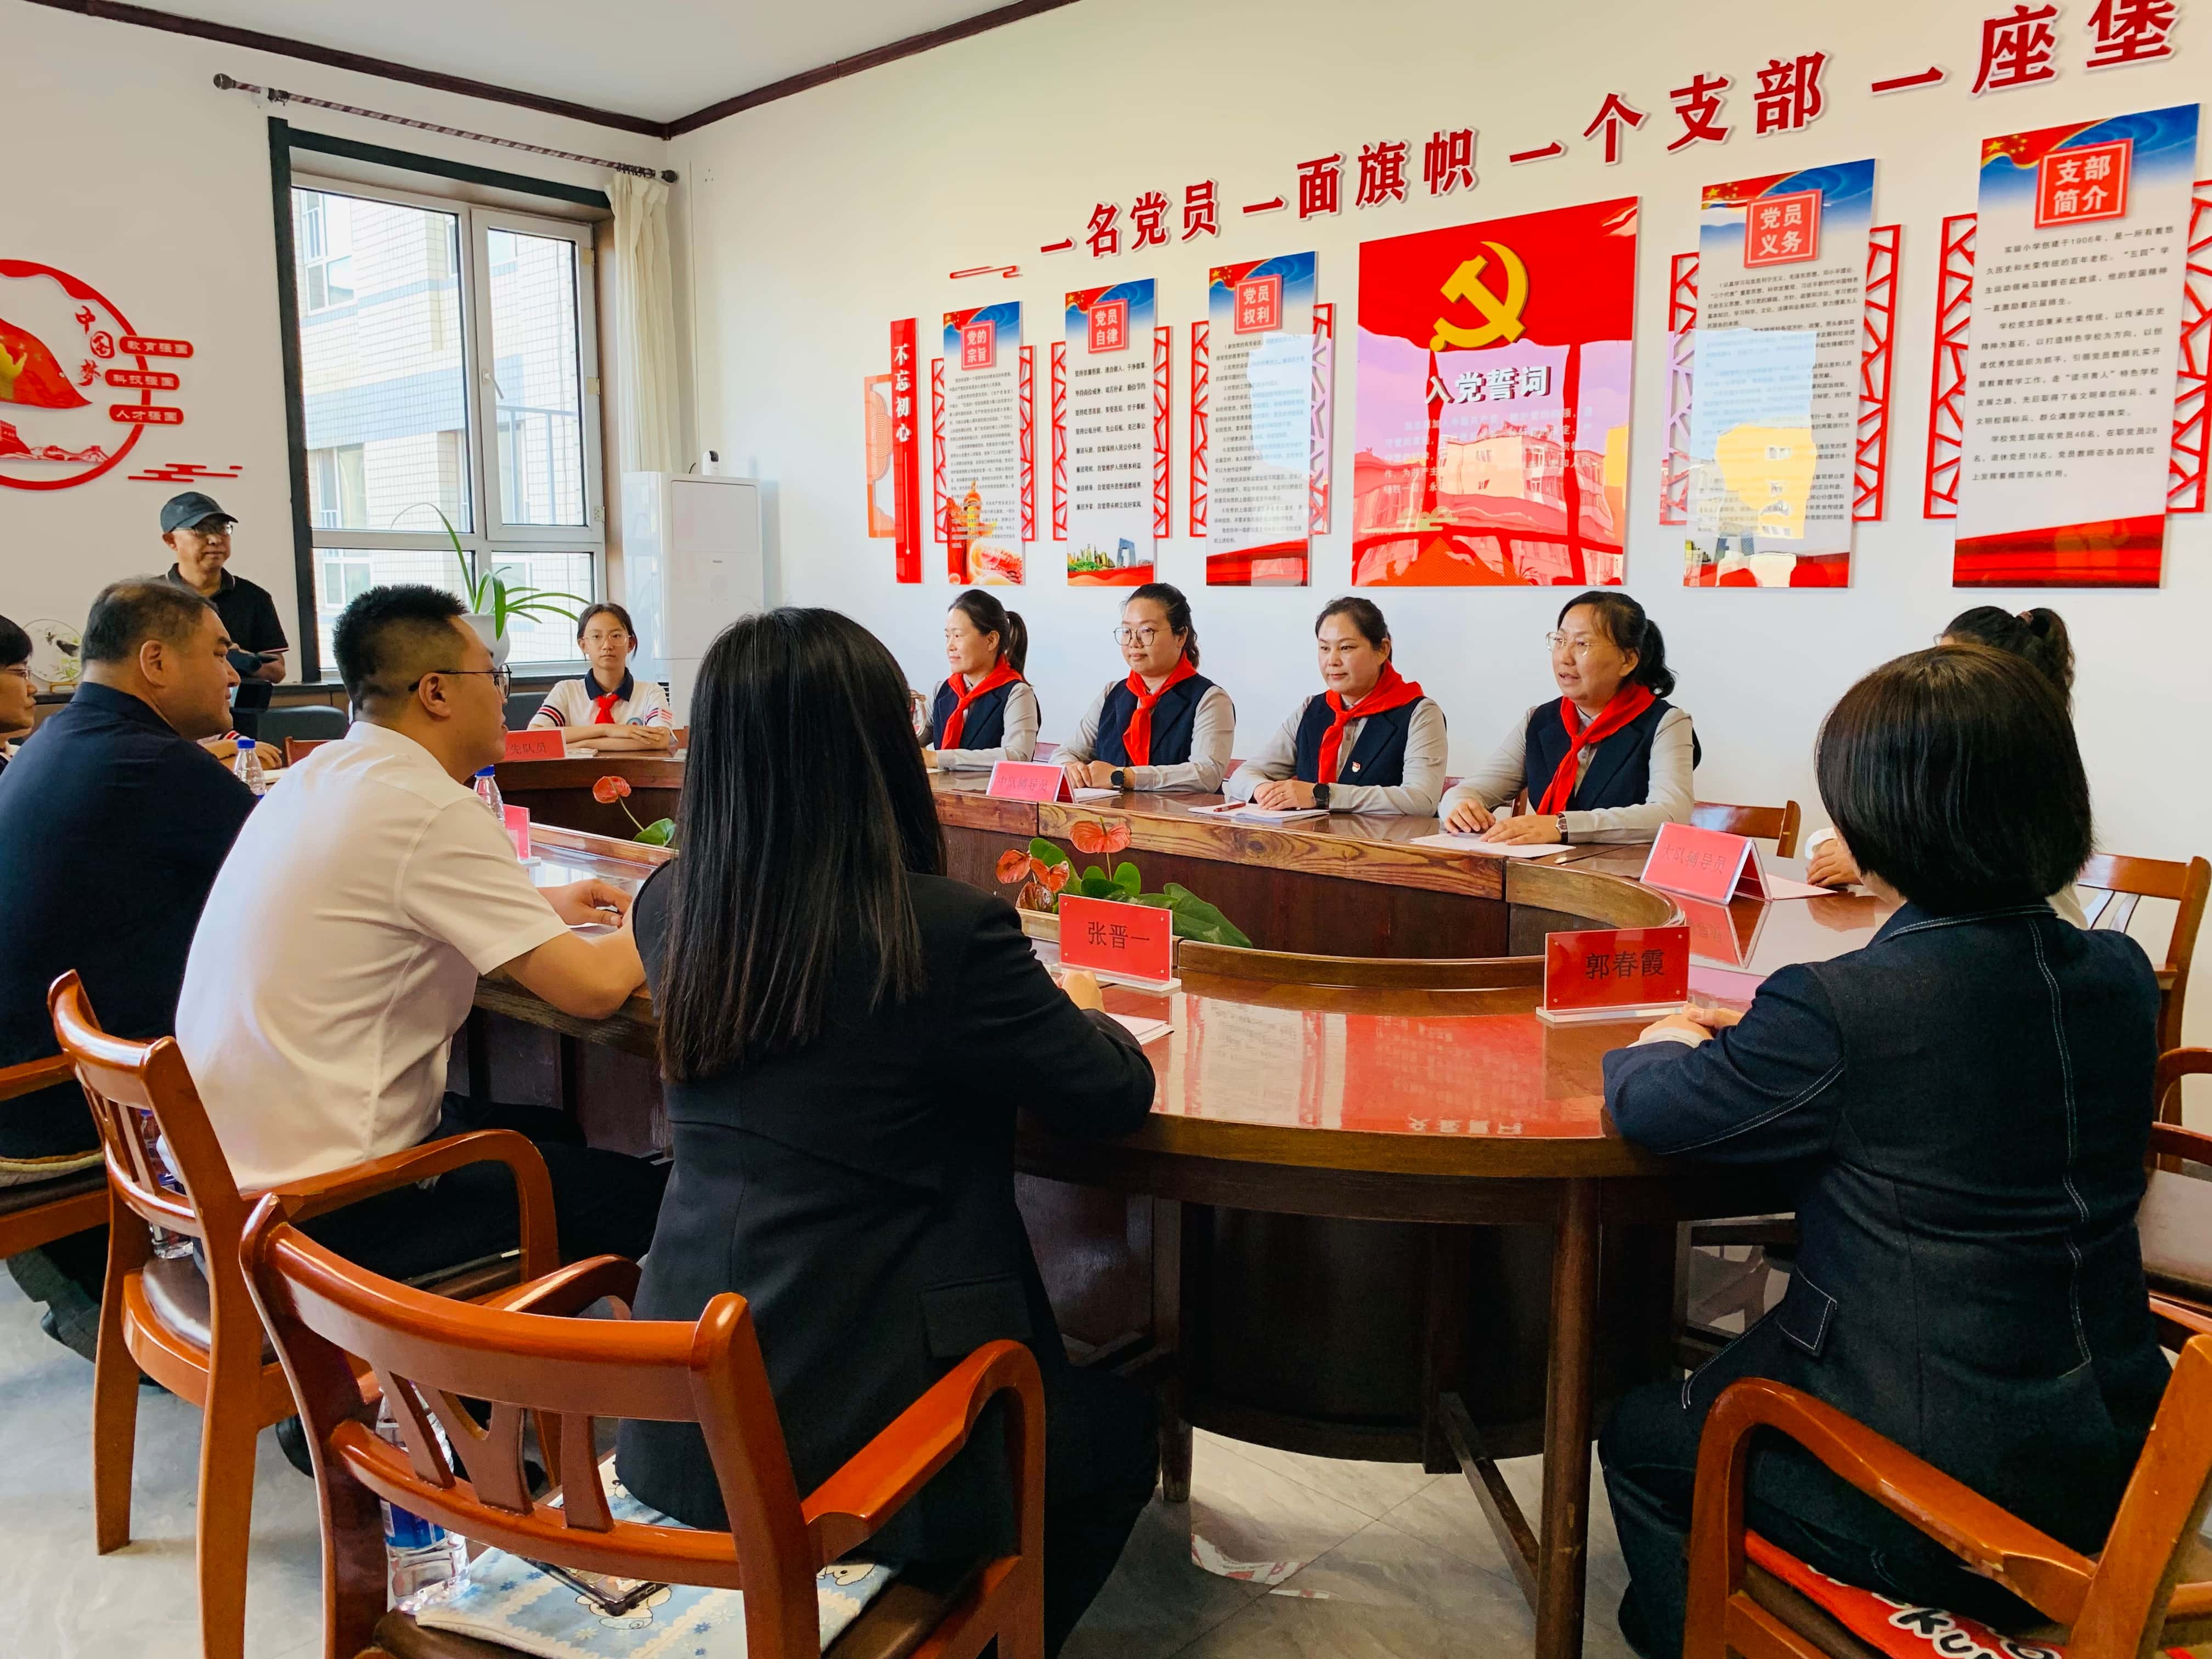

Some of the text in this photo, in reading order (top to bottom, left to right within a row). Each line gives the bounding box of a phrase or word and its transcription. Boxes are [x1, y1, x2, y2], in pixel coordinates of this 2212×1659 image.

[1040, 0, 2176, 257] 一名党员 一面旗帜 一个支部 一座堡
[2056, 155, 2112, 185] 支部
[2053, 185, 2109, 216] 简介
[1760, 204, 1803, 230] 党员
[1758, 232, 1804, 257] 义务
[1243, 285, 1269, 306] 党员
[1095, 308, 1118, 327] 党员
[1243, 307, 1269, 325] 权利
[967, 329, 986, 345] 党的
[1096, 328, 1119, 347] 自律
[967, 348, 987, 364] 宗旨
[894, 343, 912, 443] 不忘初心
[1425, 365, 1551, 404] 入党誓词
[997, 774, 1049, 793] 中队辅导员
[1660, 843, 1729, 876] 大队辅导员
[1088, 921, 1150, 949] 张晋一
[1585, 949, 1665, 980] 郭春霞
